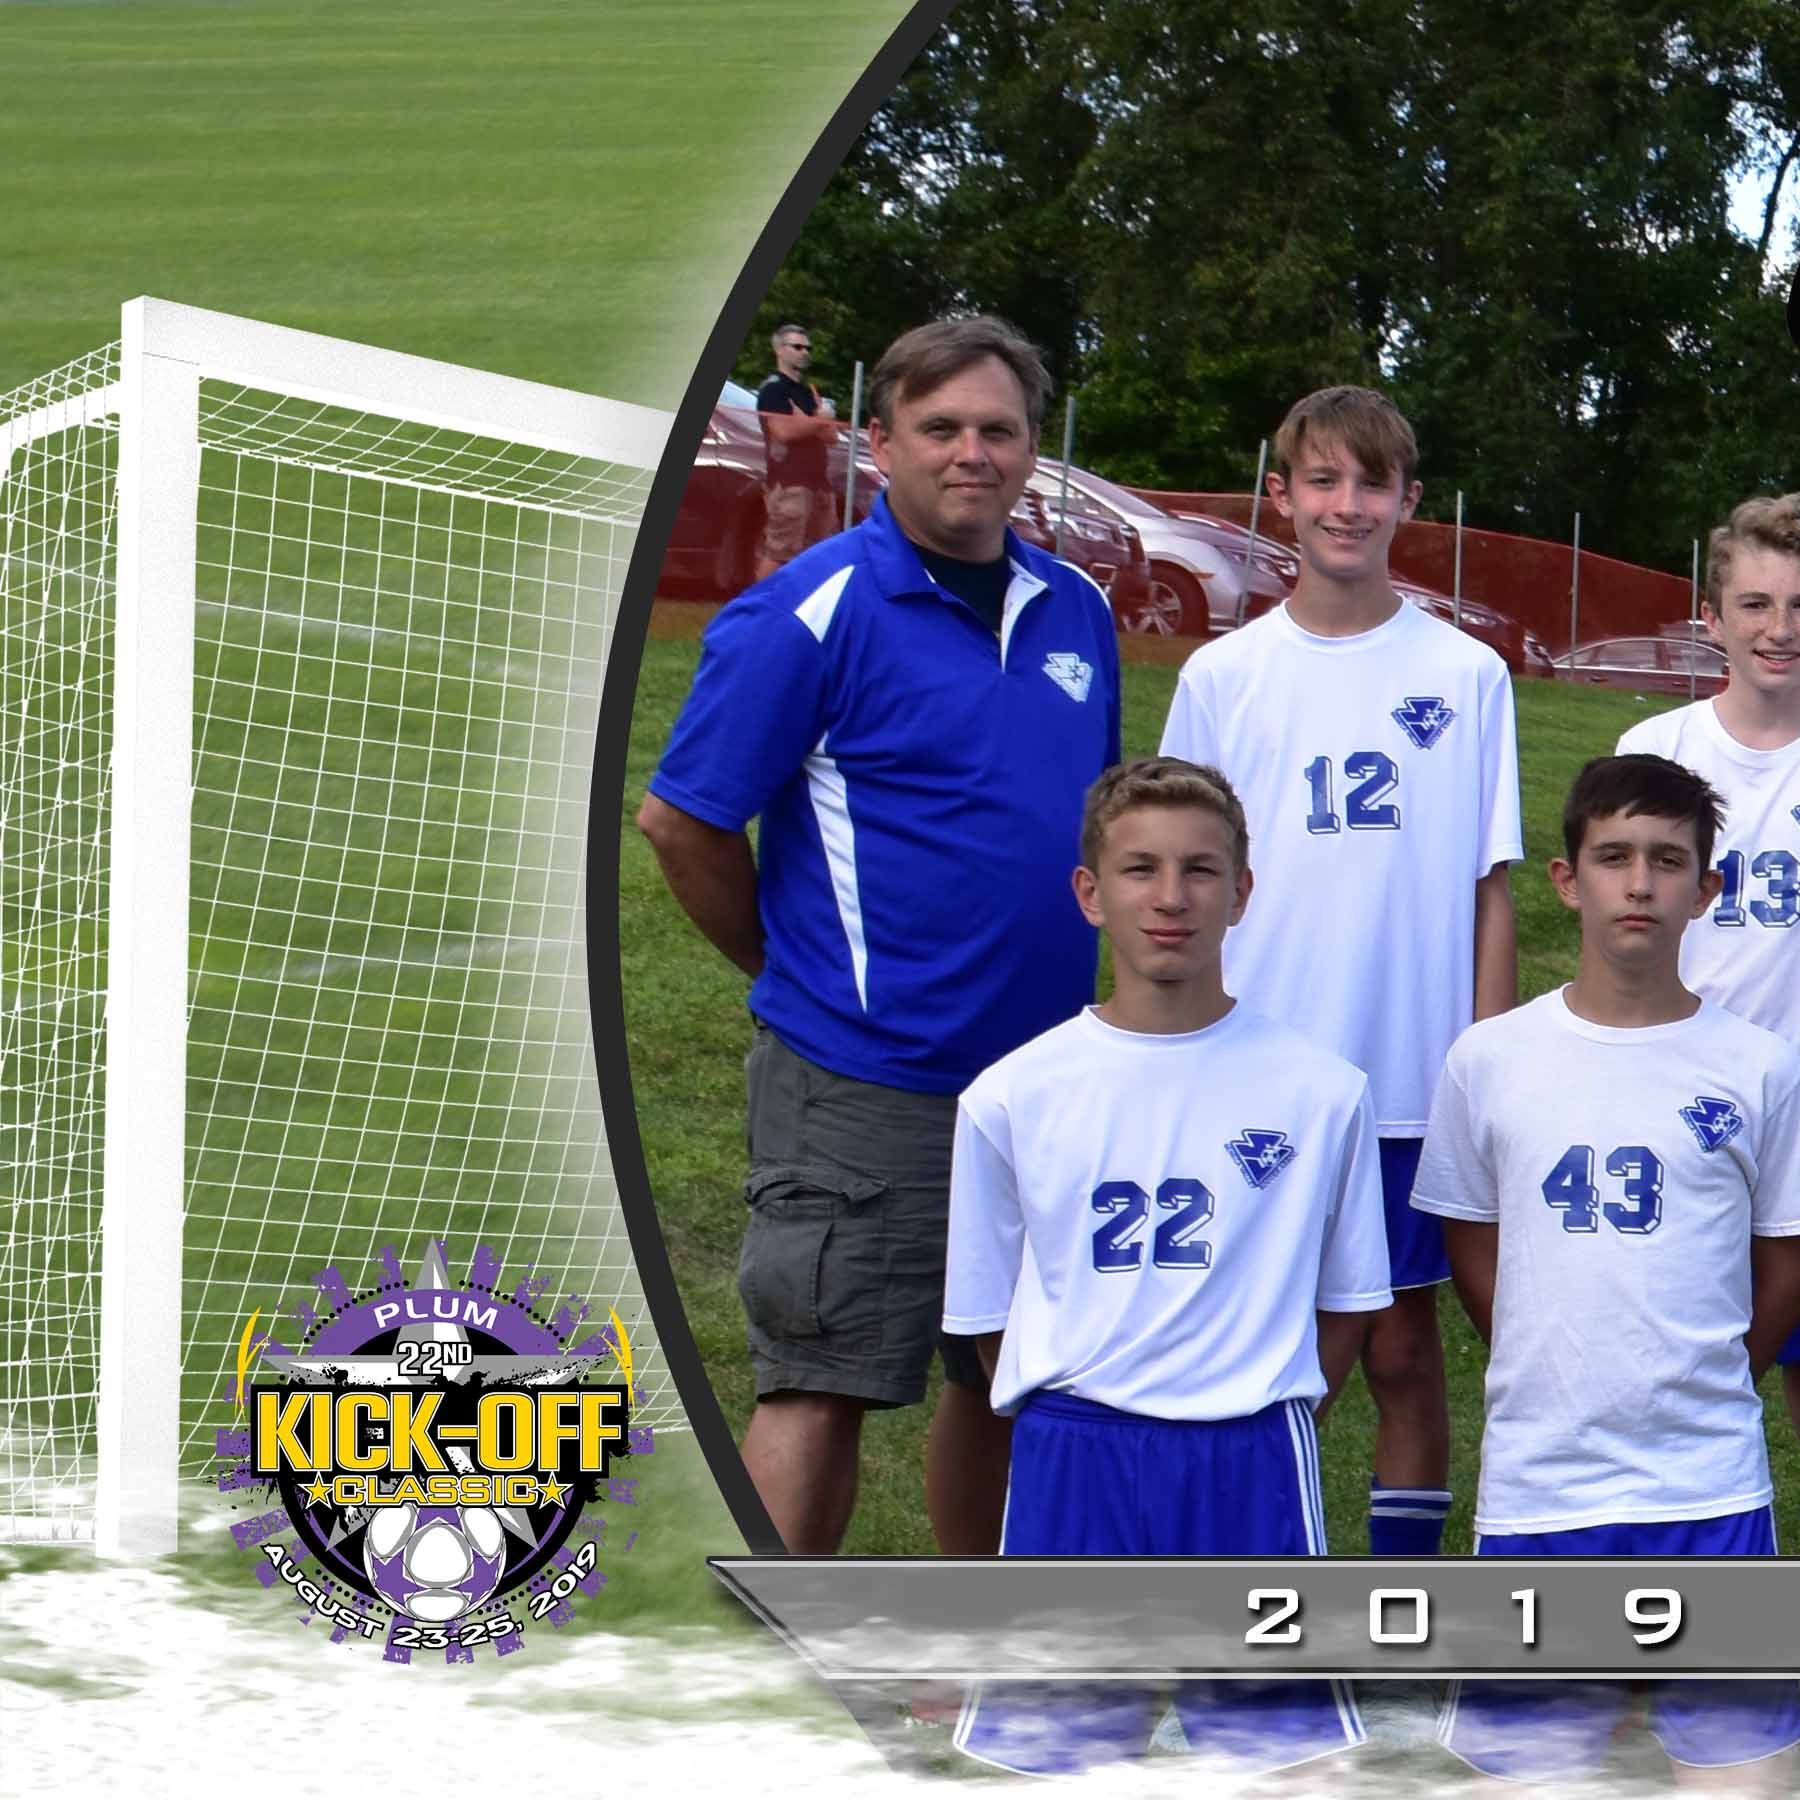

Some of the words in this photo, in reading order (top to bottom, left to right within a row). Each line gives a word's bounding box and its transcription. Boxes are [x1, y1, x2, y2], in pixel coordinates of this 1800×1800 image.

[1305, 752, 1401, 835] 12
[1092, 1177, 1216, 1274] 22
[1542, 1145, 1666, 1235] 43
